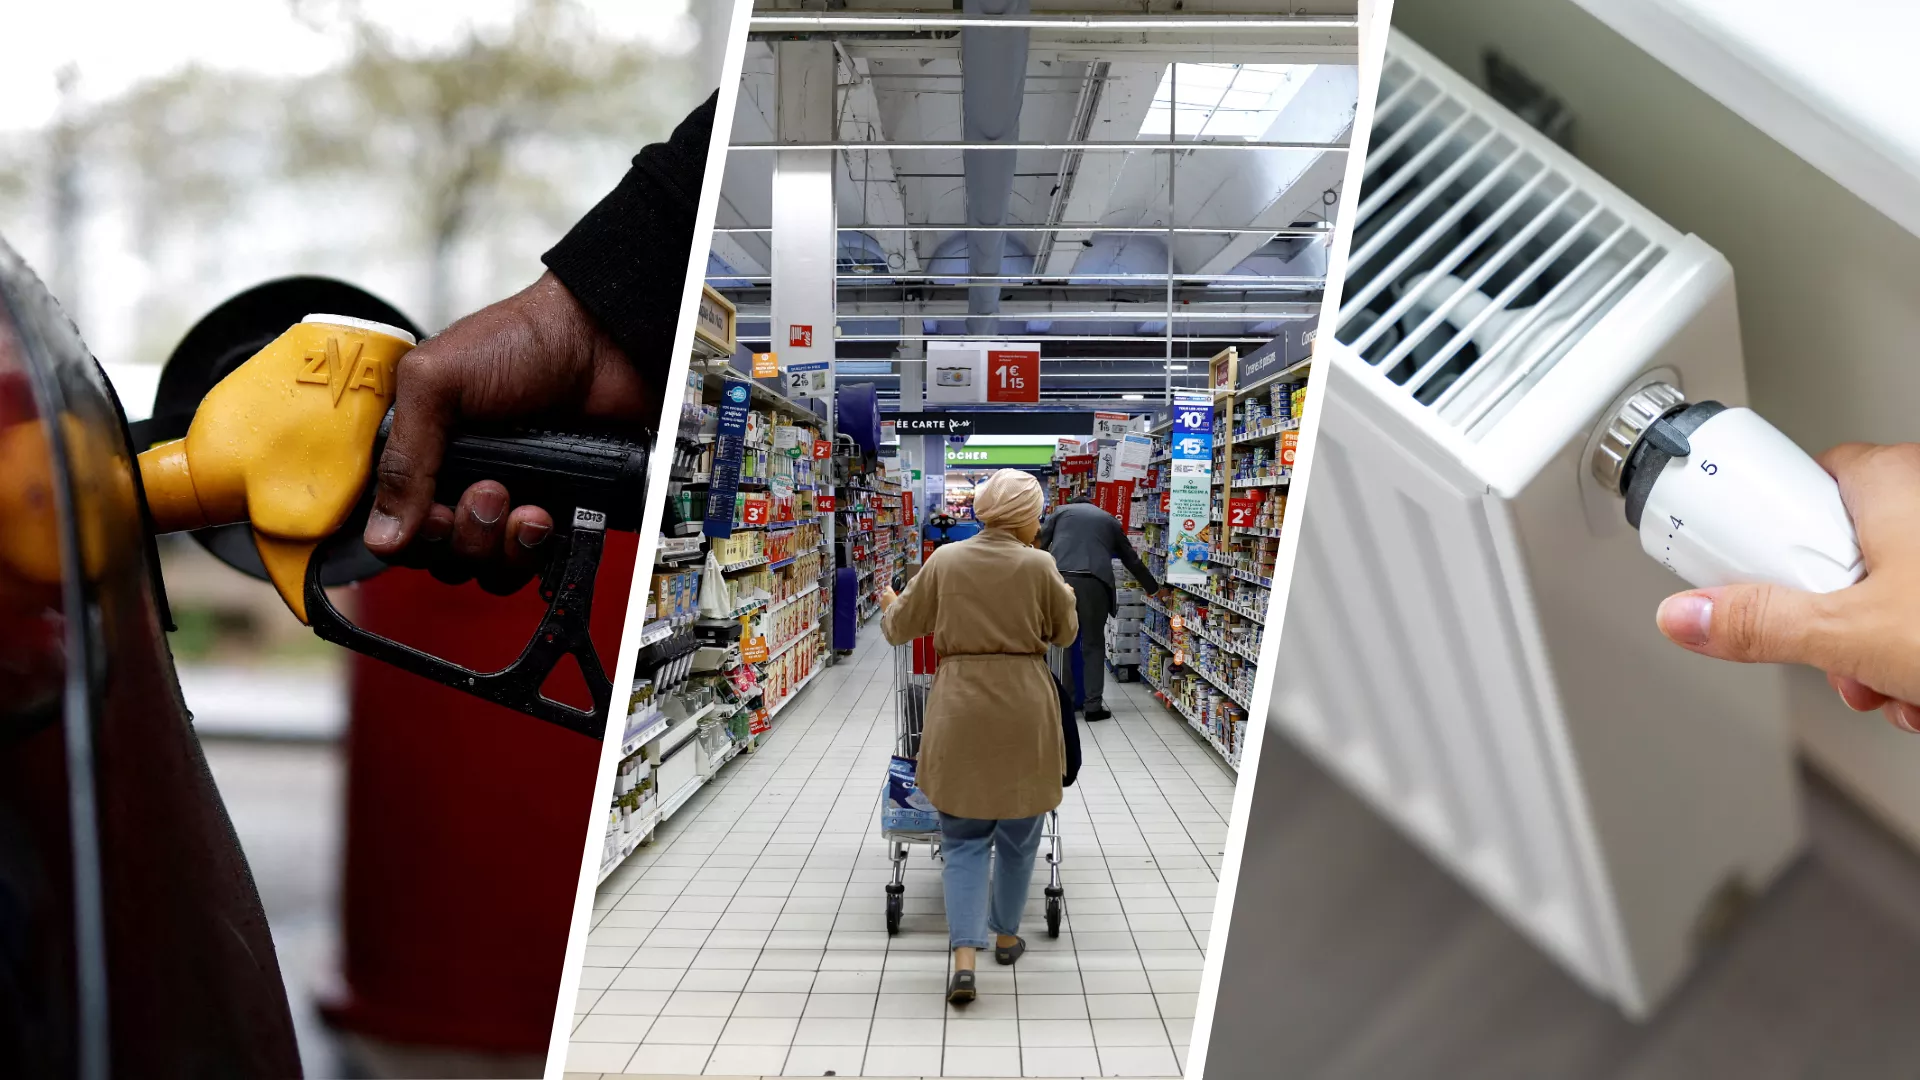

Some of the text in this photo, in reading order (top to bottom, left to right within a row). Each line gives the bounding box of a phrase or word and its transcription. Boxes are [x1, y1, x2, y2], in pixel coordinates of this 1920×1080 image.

[296, 338, 384, 408] ZVA
[911, 420, 946, 429] CARTE
[948, 418, 972, 433] pass
[945, 451, 988, 460] OCHER
[1700, 459, 1718, 476] 5
[820, 500, 831, 509] 4€
[576, 510, 604, 523] 2013
[1669, 515, 1684, 530] 4
